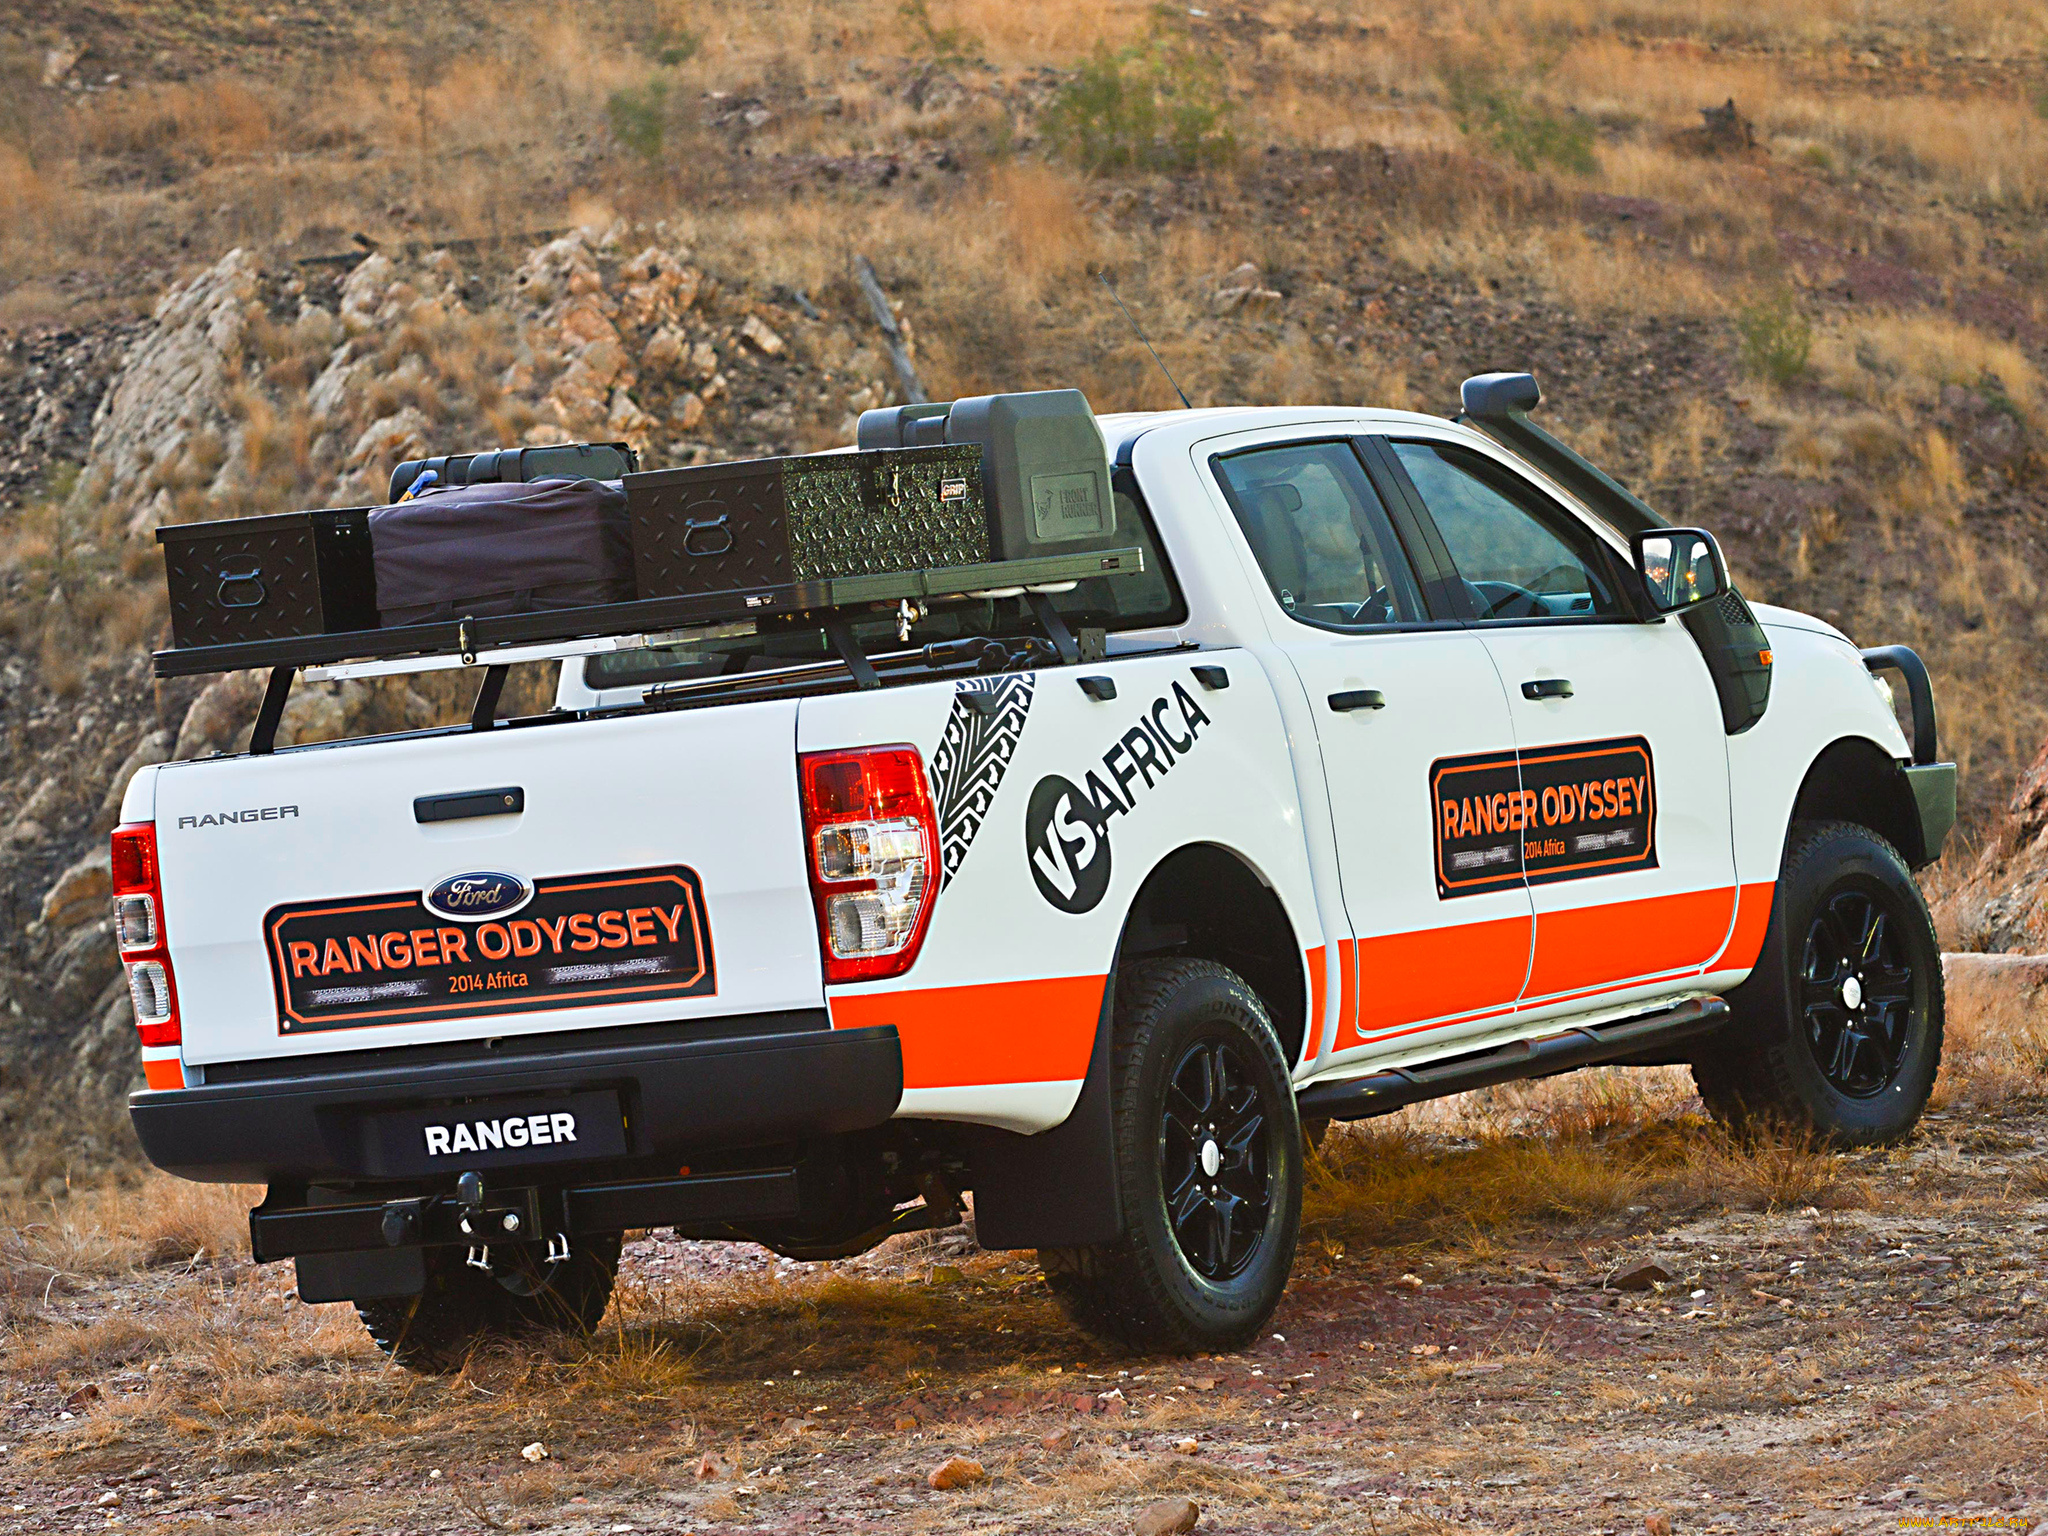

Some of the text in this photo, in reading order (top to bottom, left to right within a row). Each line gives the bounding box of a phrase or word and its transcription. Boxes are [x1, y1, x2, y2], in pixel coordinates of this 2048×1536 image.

[943, 483, 965, 497] GRIP
[1059, 487, 1089, 504] FRONT
[1060, 502, 1099, 520] RUNNER
[1085, 680, 1211, 833] AFRICA
[178, 805, 300, 830] RANGER
[1442, 775, 1646, 840] RANGER ODYSSEY
[1523, 839, 1566, 860] 2014 Africa
[446, 878, 503, 908] Ford
[287, 903, 685, 979] RANGER ODYSSEY
[448, 971, 529, 994] 2014 Africa
[424, 1112, 578, 1156] RANGER
